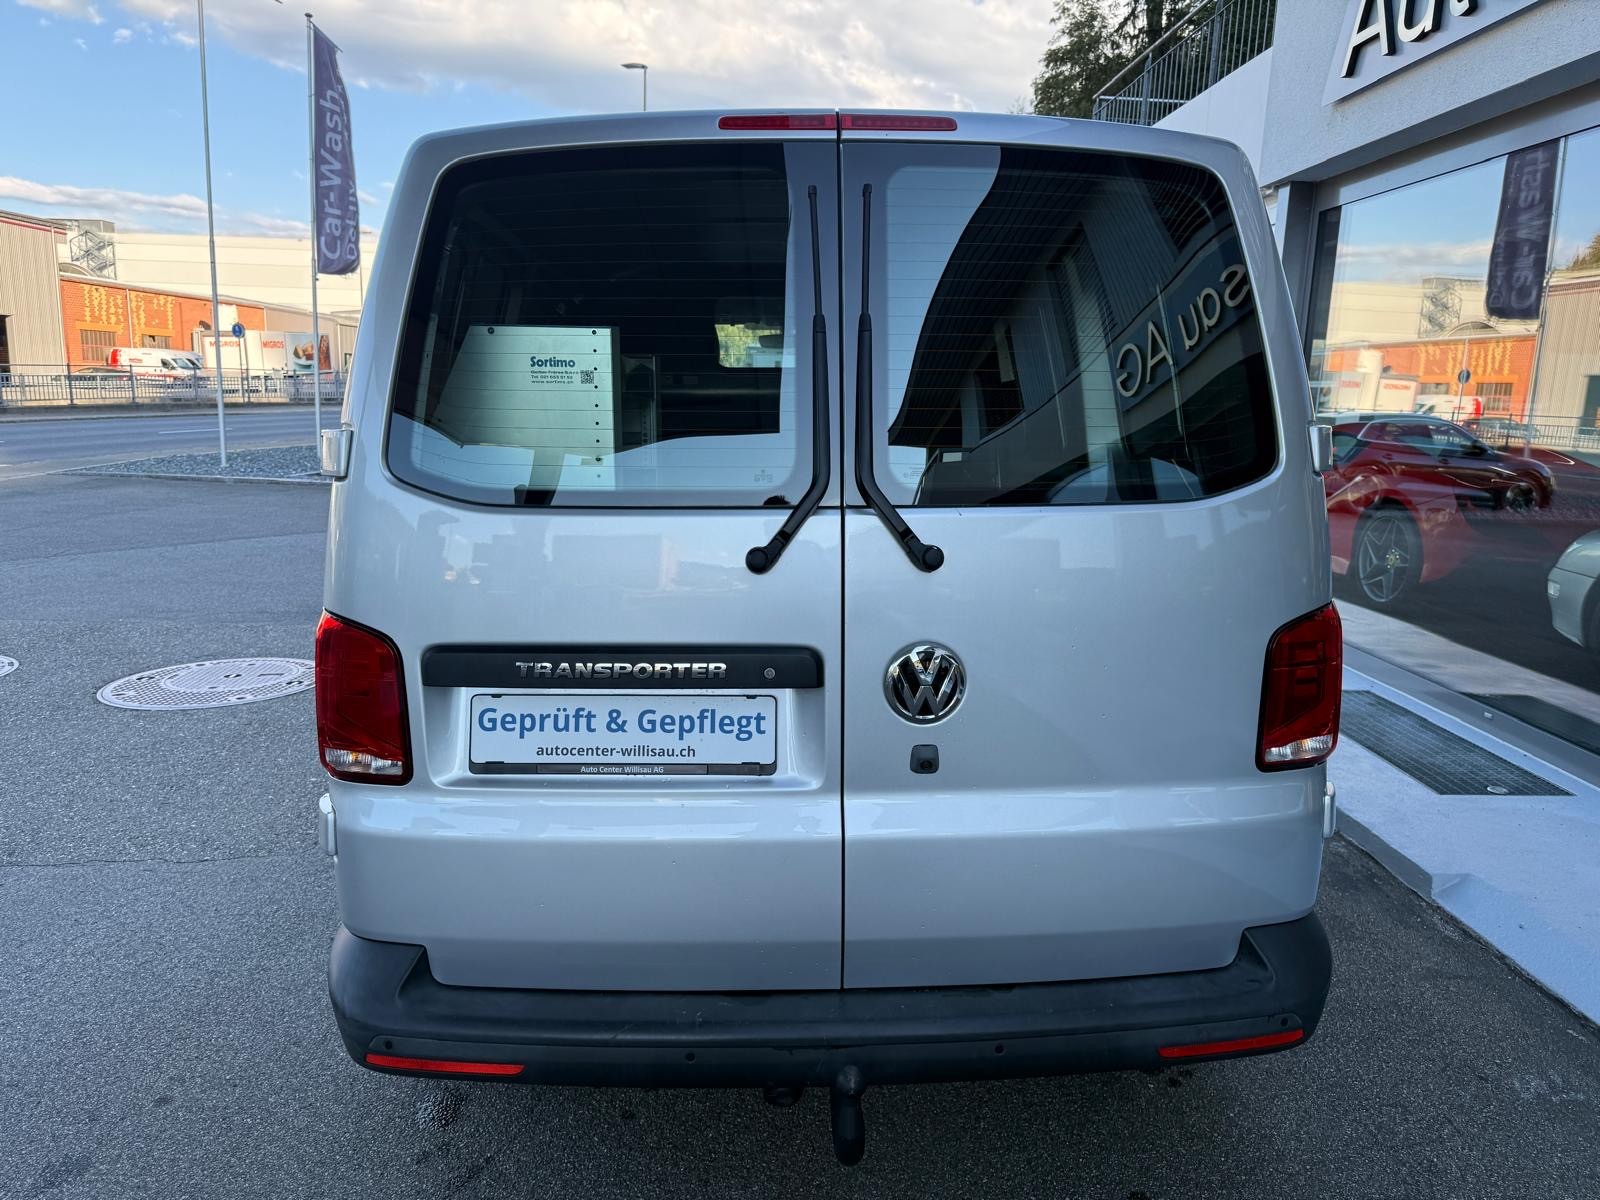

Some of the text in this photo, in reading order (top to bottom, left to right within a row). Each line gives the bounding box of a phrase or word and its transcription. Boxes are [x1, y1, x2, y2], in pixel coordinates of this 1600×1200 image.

[1340, 0, 1478, 78] Au
[319, 89, 342, 259] Car-Wash
[530, 356, 576, 368] Sortimo
[515, 661, 728, 679] TRANSPORTER
[478, 707, 767, 742] Geprüft & Gepflegt
[536, 745, 696, 758] autocenter-willisau.ch
